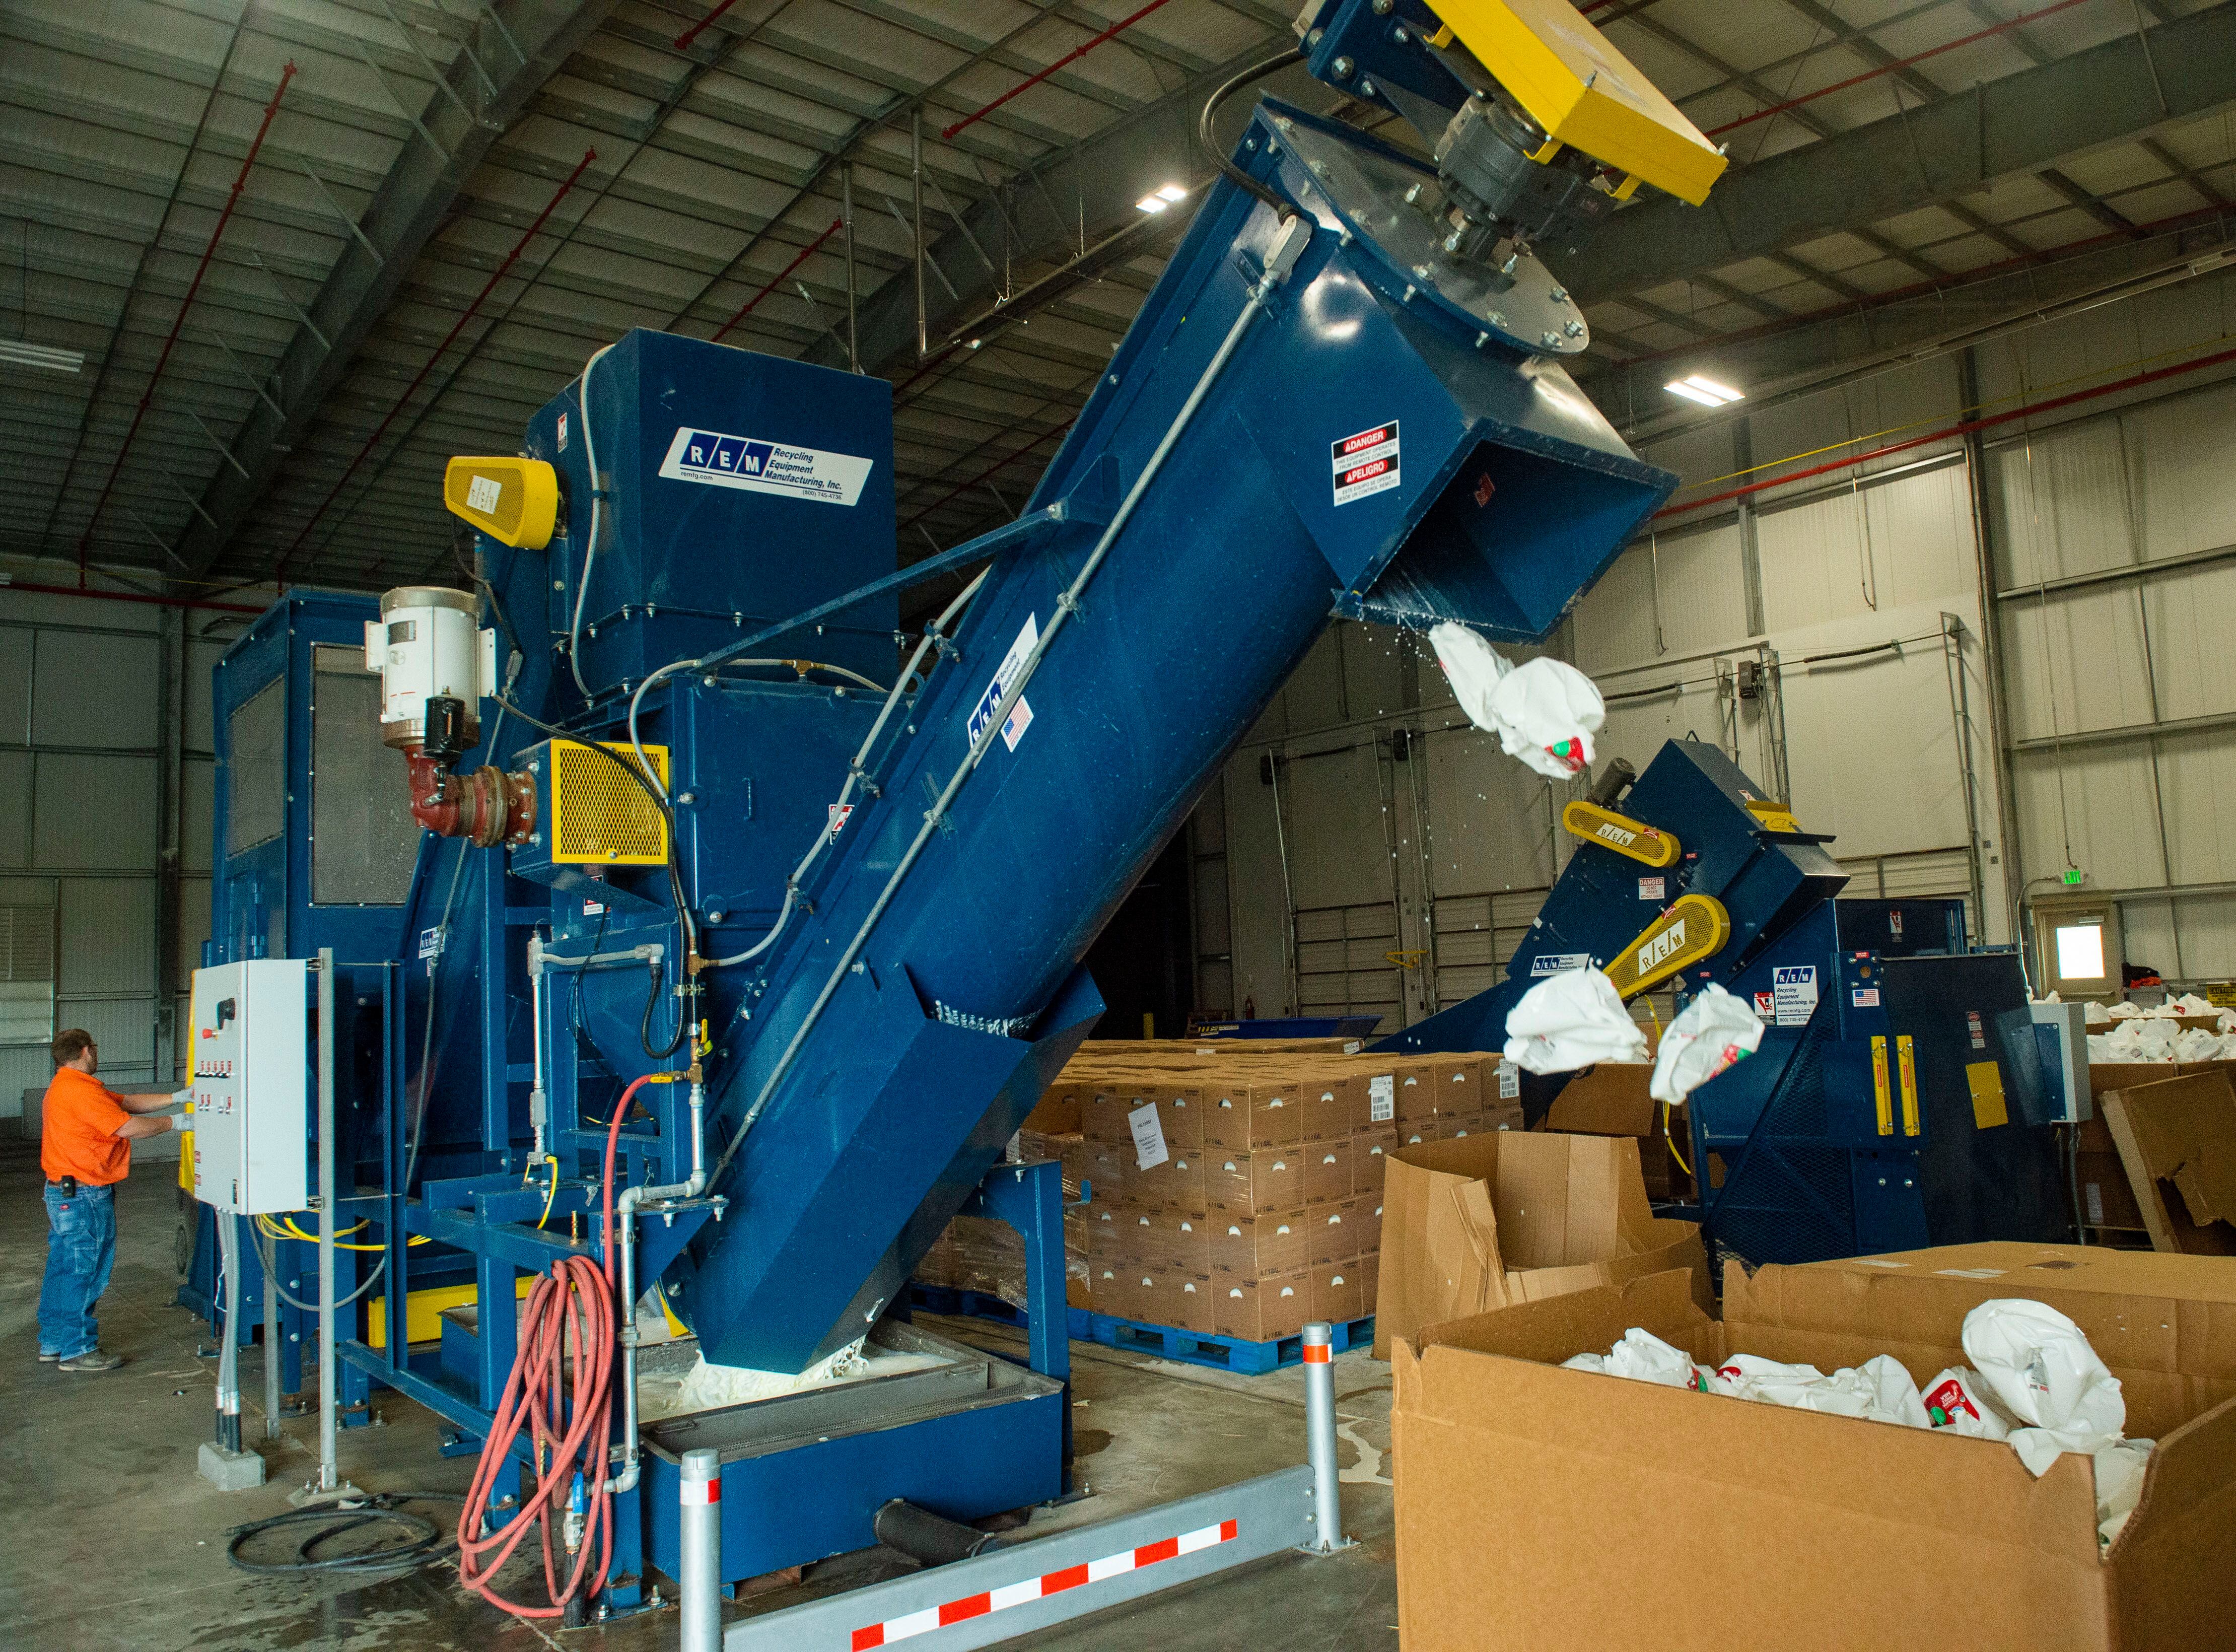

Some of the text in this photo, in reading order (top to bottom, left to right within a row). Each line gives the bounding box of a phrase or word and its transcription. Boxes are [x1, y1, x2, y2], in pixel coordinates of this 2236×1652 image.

[1352, 431, 1384, 449] DANGER
[691, 445, 760, 473] REM
[774, 448, 814, 463] Recycling
[1347, 451, 1371, 462] EQUIPMENT
[1372, 441, 1395, 453] OPERATES
[1353, 457, 1370, 466] REMOTE
[1371, 449, 1392, 459] CONTROL
[680, 470, 713, 480] remfg.com
[769, 461, 813, 474] Equipment
[1352, 462, 1384, 480] PELIGRO
[764, 470, 842, 490] Manufacturing, Inc.
[802, 490, 842, 500] (800) 745-4736
[1779, 974, 1809, 982] REM
